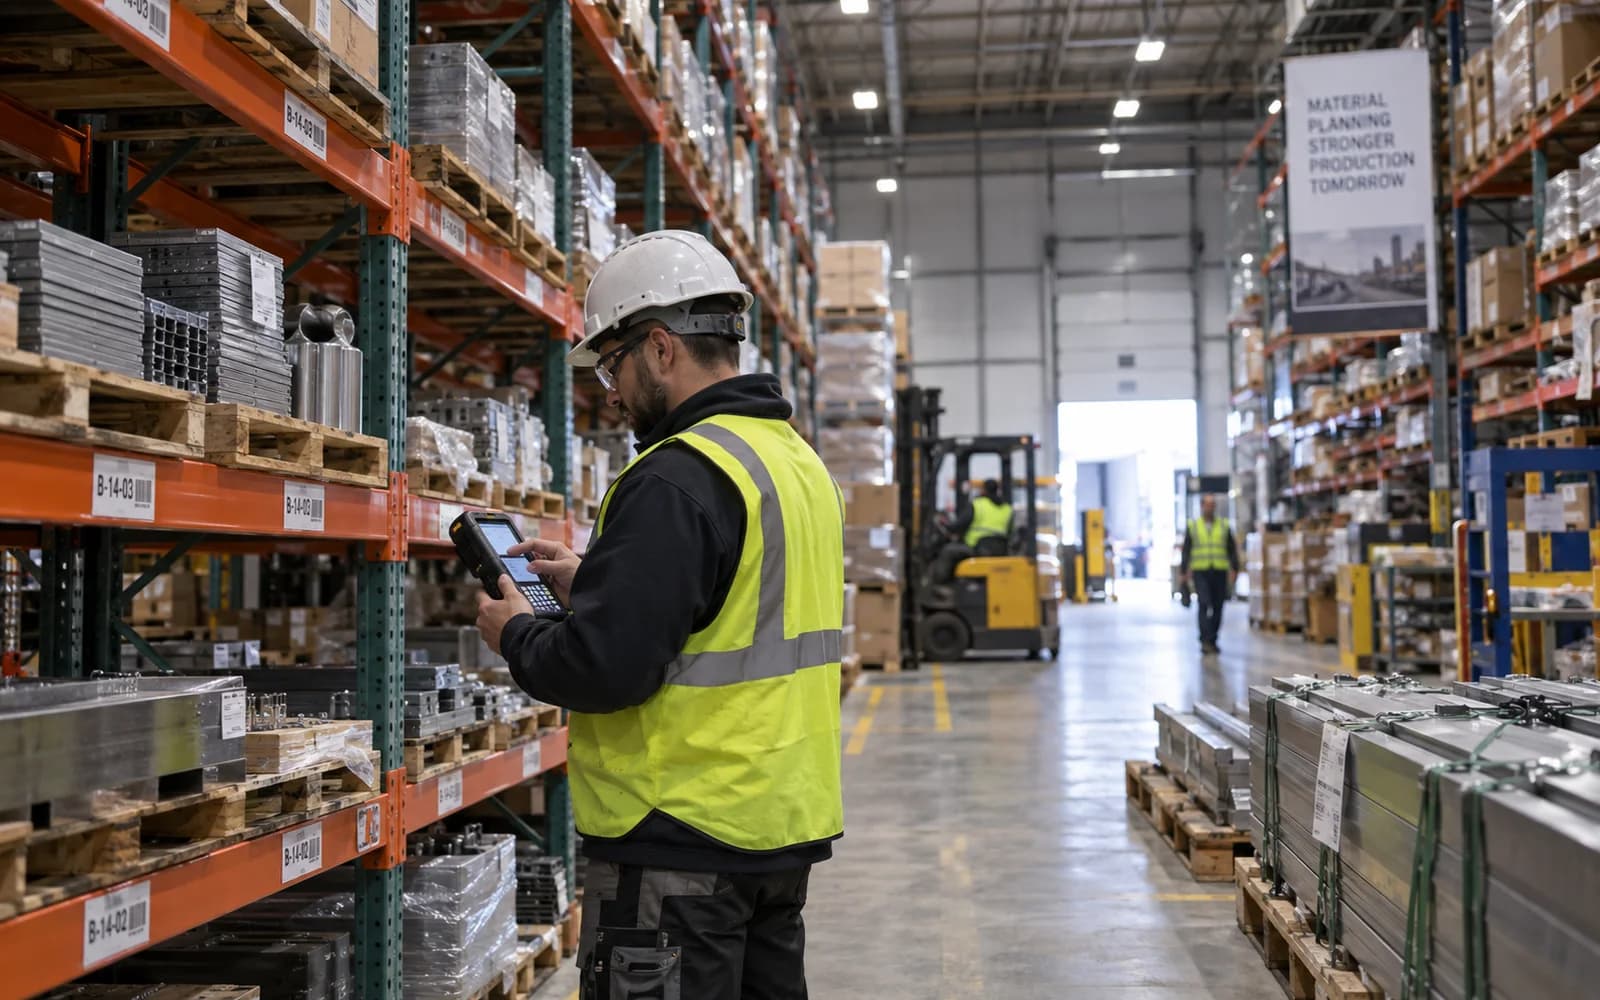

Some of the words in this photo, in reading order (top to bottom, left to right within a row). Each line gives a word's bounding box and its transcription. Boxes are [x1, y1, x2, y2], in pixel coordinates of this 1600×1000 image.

[1308, 93, 1387, 111] MATERIAL
[1308, 112, 1391, 132] PLANNING
[1309, 132, 1395, 153] STRONGER
[1310, 151, 1415, 173] PRODUCTION
[1310, 173, 1406, 194] TOMORROW
[97, 474, 134, 499] B-14-03
[284, 840, 309, 867] B-14-02
[89, 908, 127, 945] B-14-02
